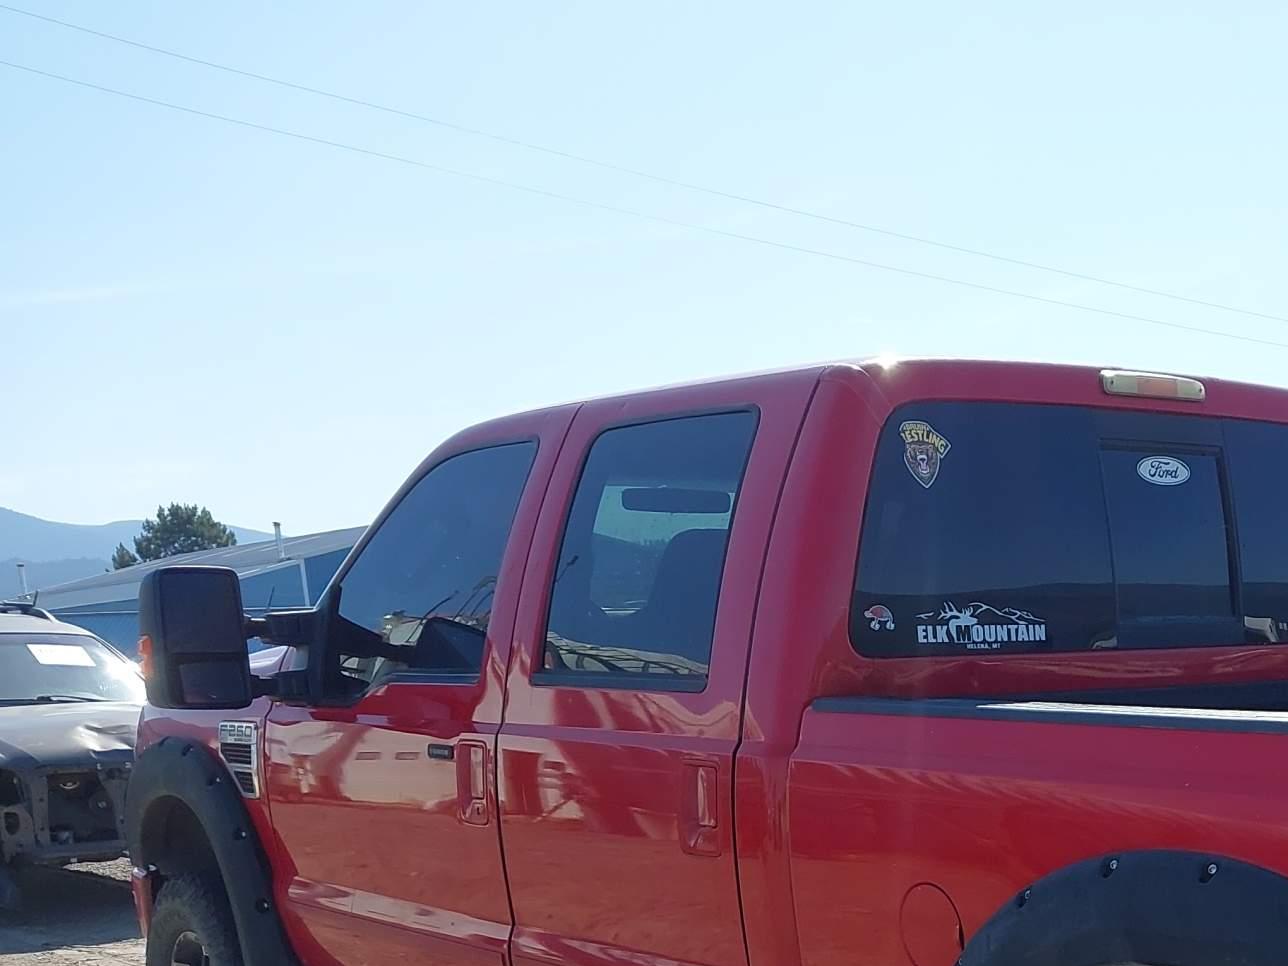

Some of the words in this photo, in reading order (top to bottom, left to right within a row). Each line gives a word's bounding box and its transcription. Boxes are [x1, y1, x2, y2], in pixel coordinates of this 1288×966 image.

[1149, 460, 1180, 479] Ford
[917, 624, 949, 643] ELK
[954, 623, 1046, 643] MOUNTAIN
